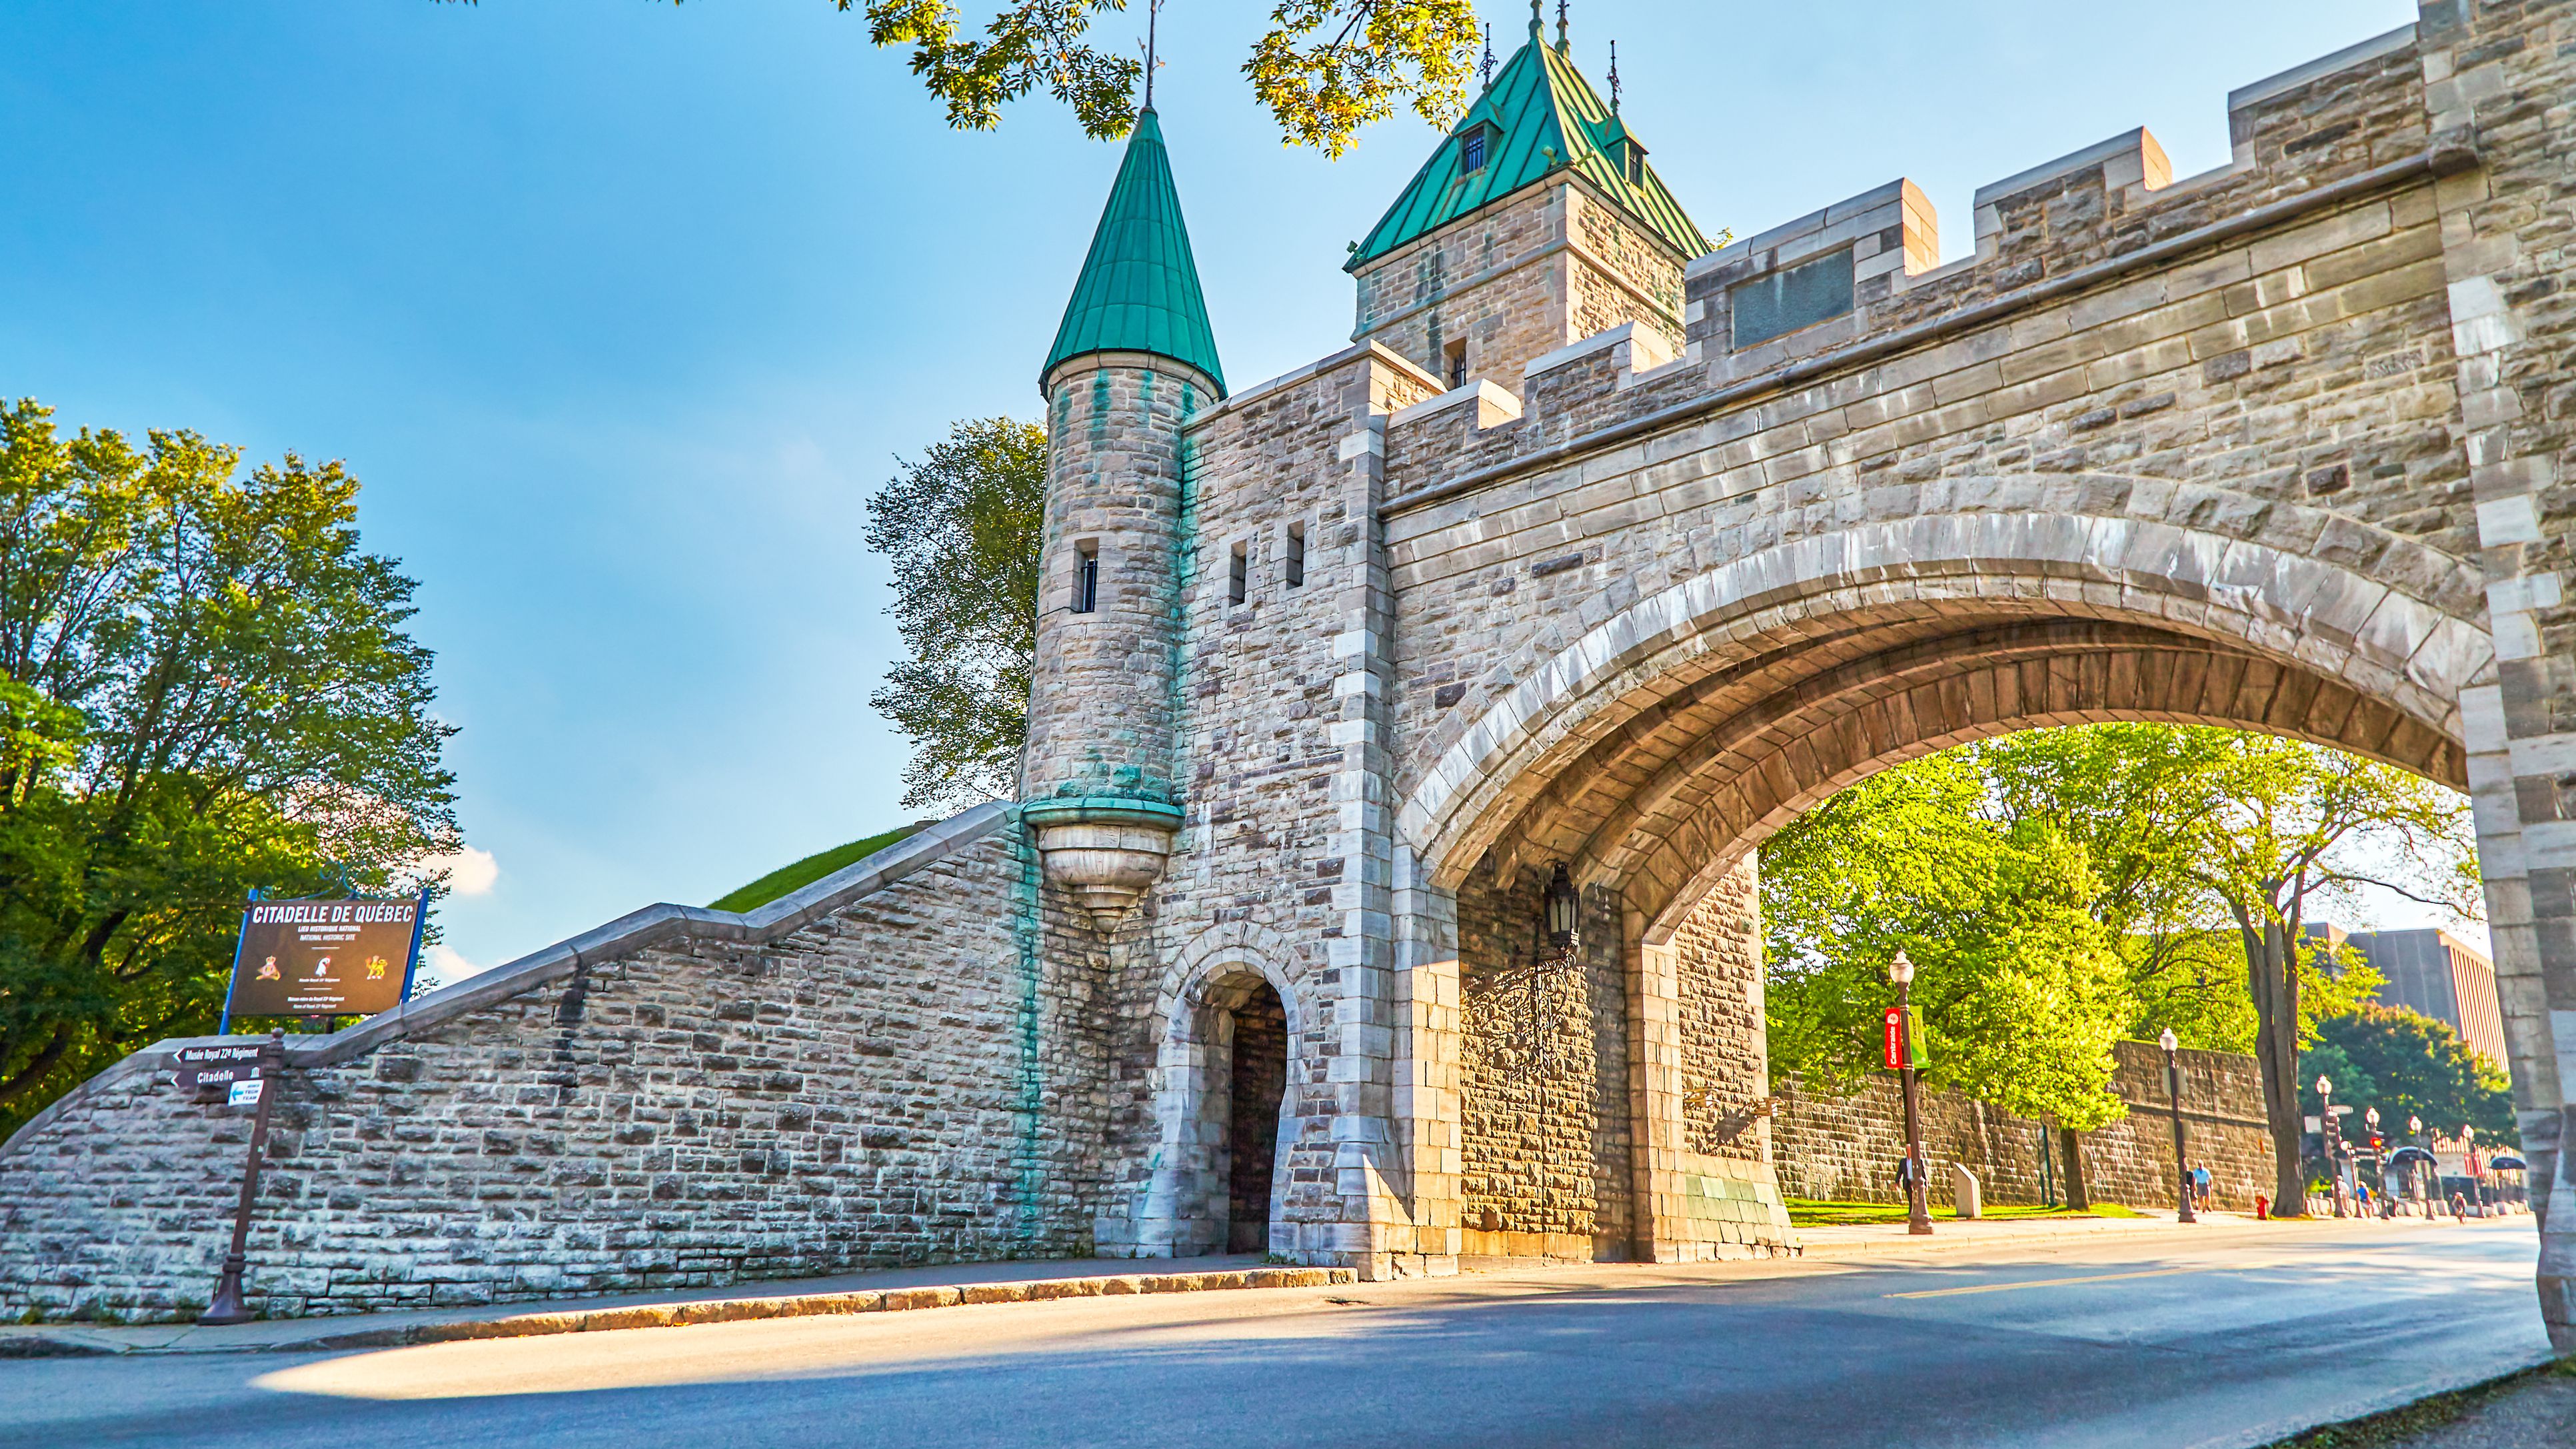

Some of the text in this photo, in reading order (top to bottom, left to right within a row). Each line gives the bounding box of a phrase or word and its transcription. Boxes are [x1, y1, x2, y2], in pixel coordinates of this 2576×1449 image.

[253, 902, 413, 923] CITADELLE DE QUÉBEC
[185, 1049, 204, 1060] Musée
[203, 1048, 221, 1062] Royal
[231, 1047, 259, 1061] Régiment
[197, 1070, 234, 1084] Citadelle
